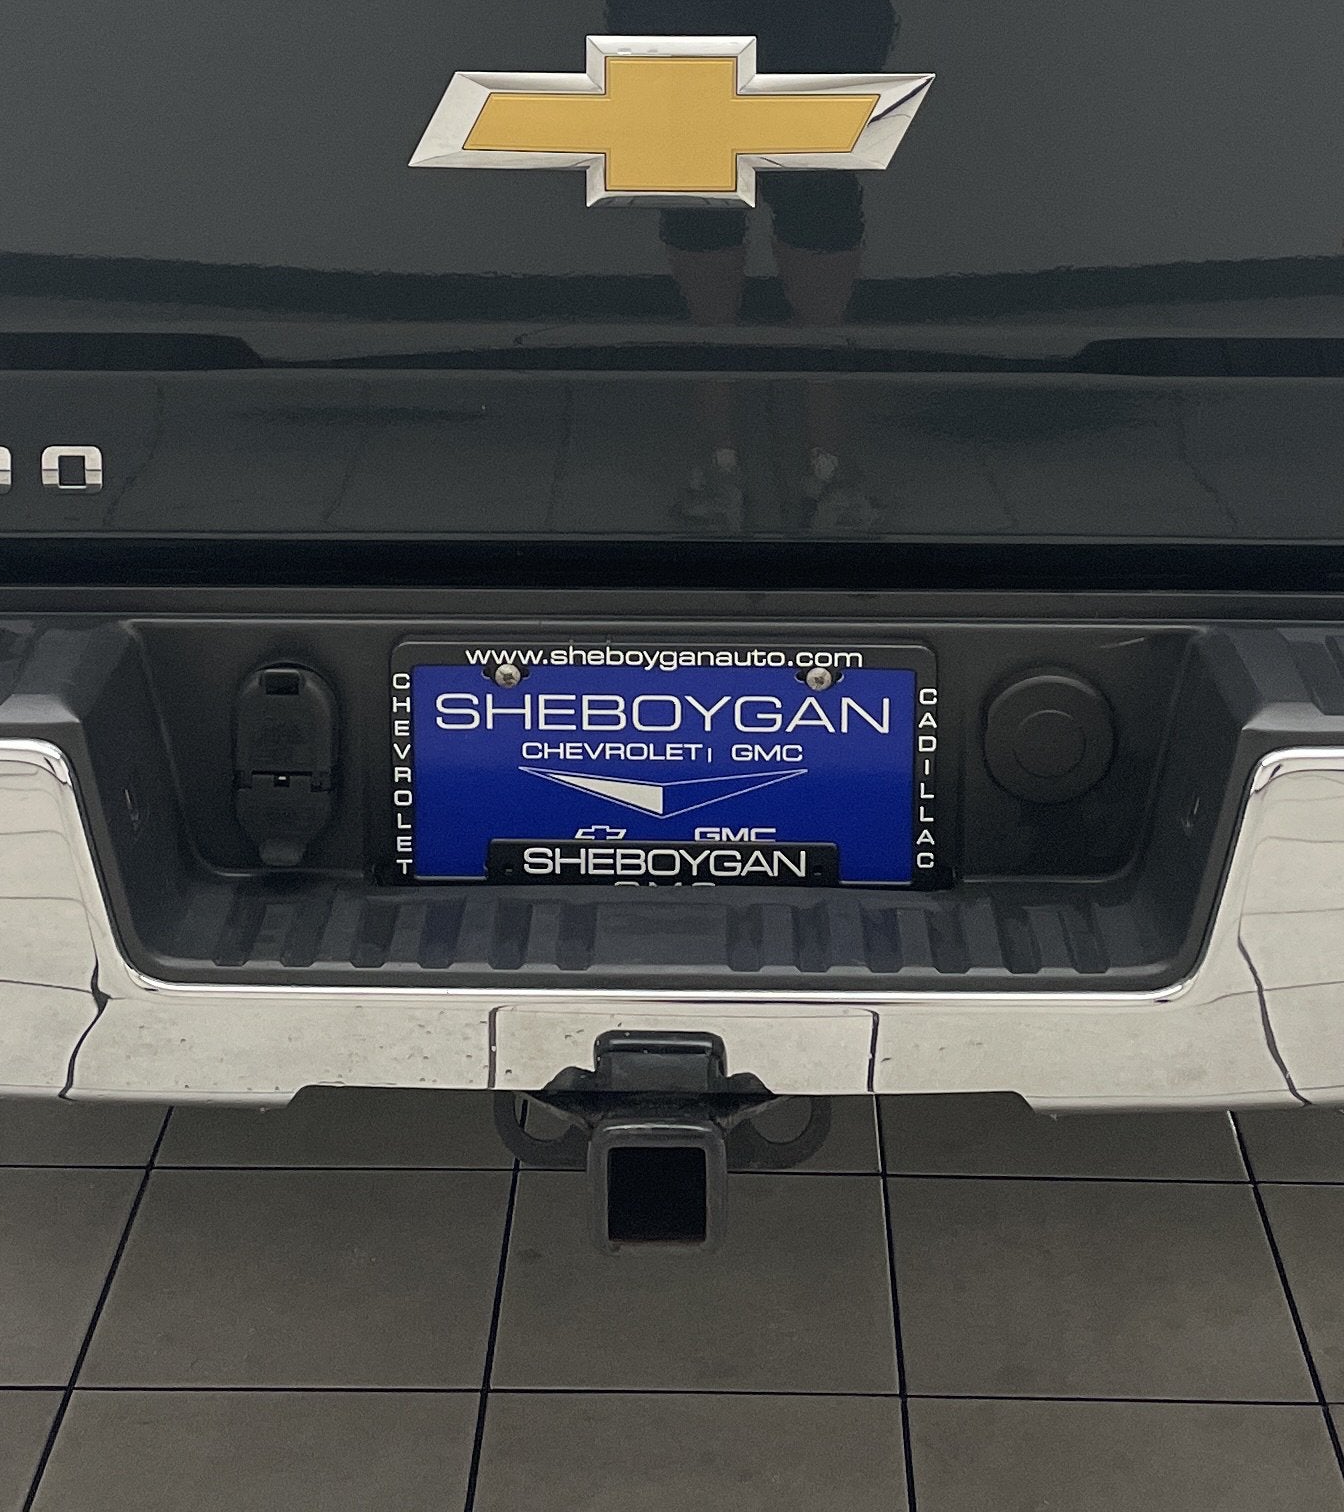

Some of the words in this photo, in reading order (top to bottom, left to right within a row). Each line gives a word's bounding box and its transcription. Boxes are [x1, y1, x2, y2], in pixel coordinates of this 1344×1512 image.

[465, 645, 864, 671] www.sheboyganauto.com
[435, 692, 890, 734] SHEBOYGAN
[521, 741, 703, 761] CHEVROLET
[731, 744, 804, 762] GMC
[392, 672, 414, 875] CHEVROLET
[916, 687, 938, 870] CADILLAC
[522, 846, 807, 878] SHEBOYGAN
